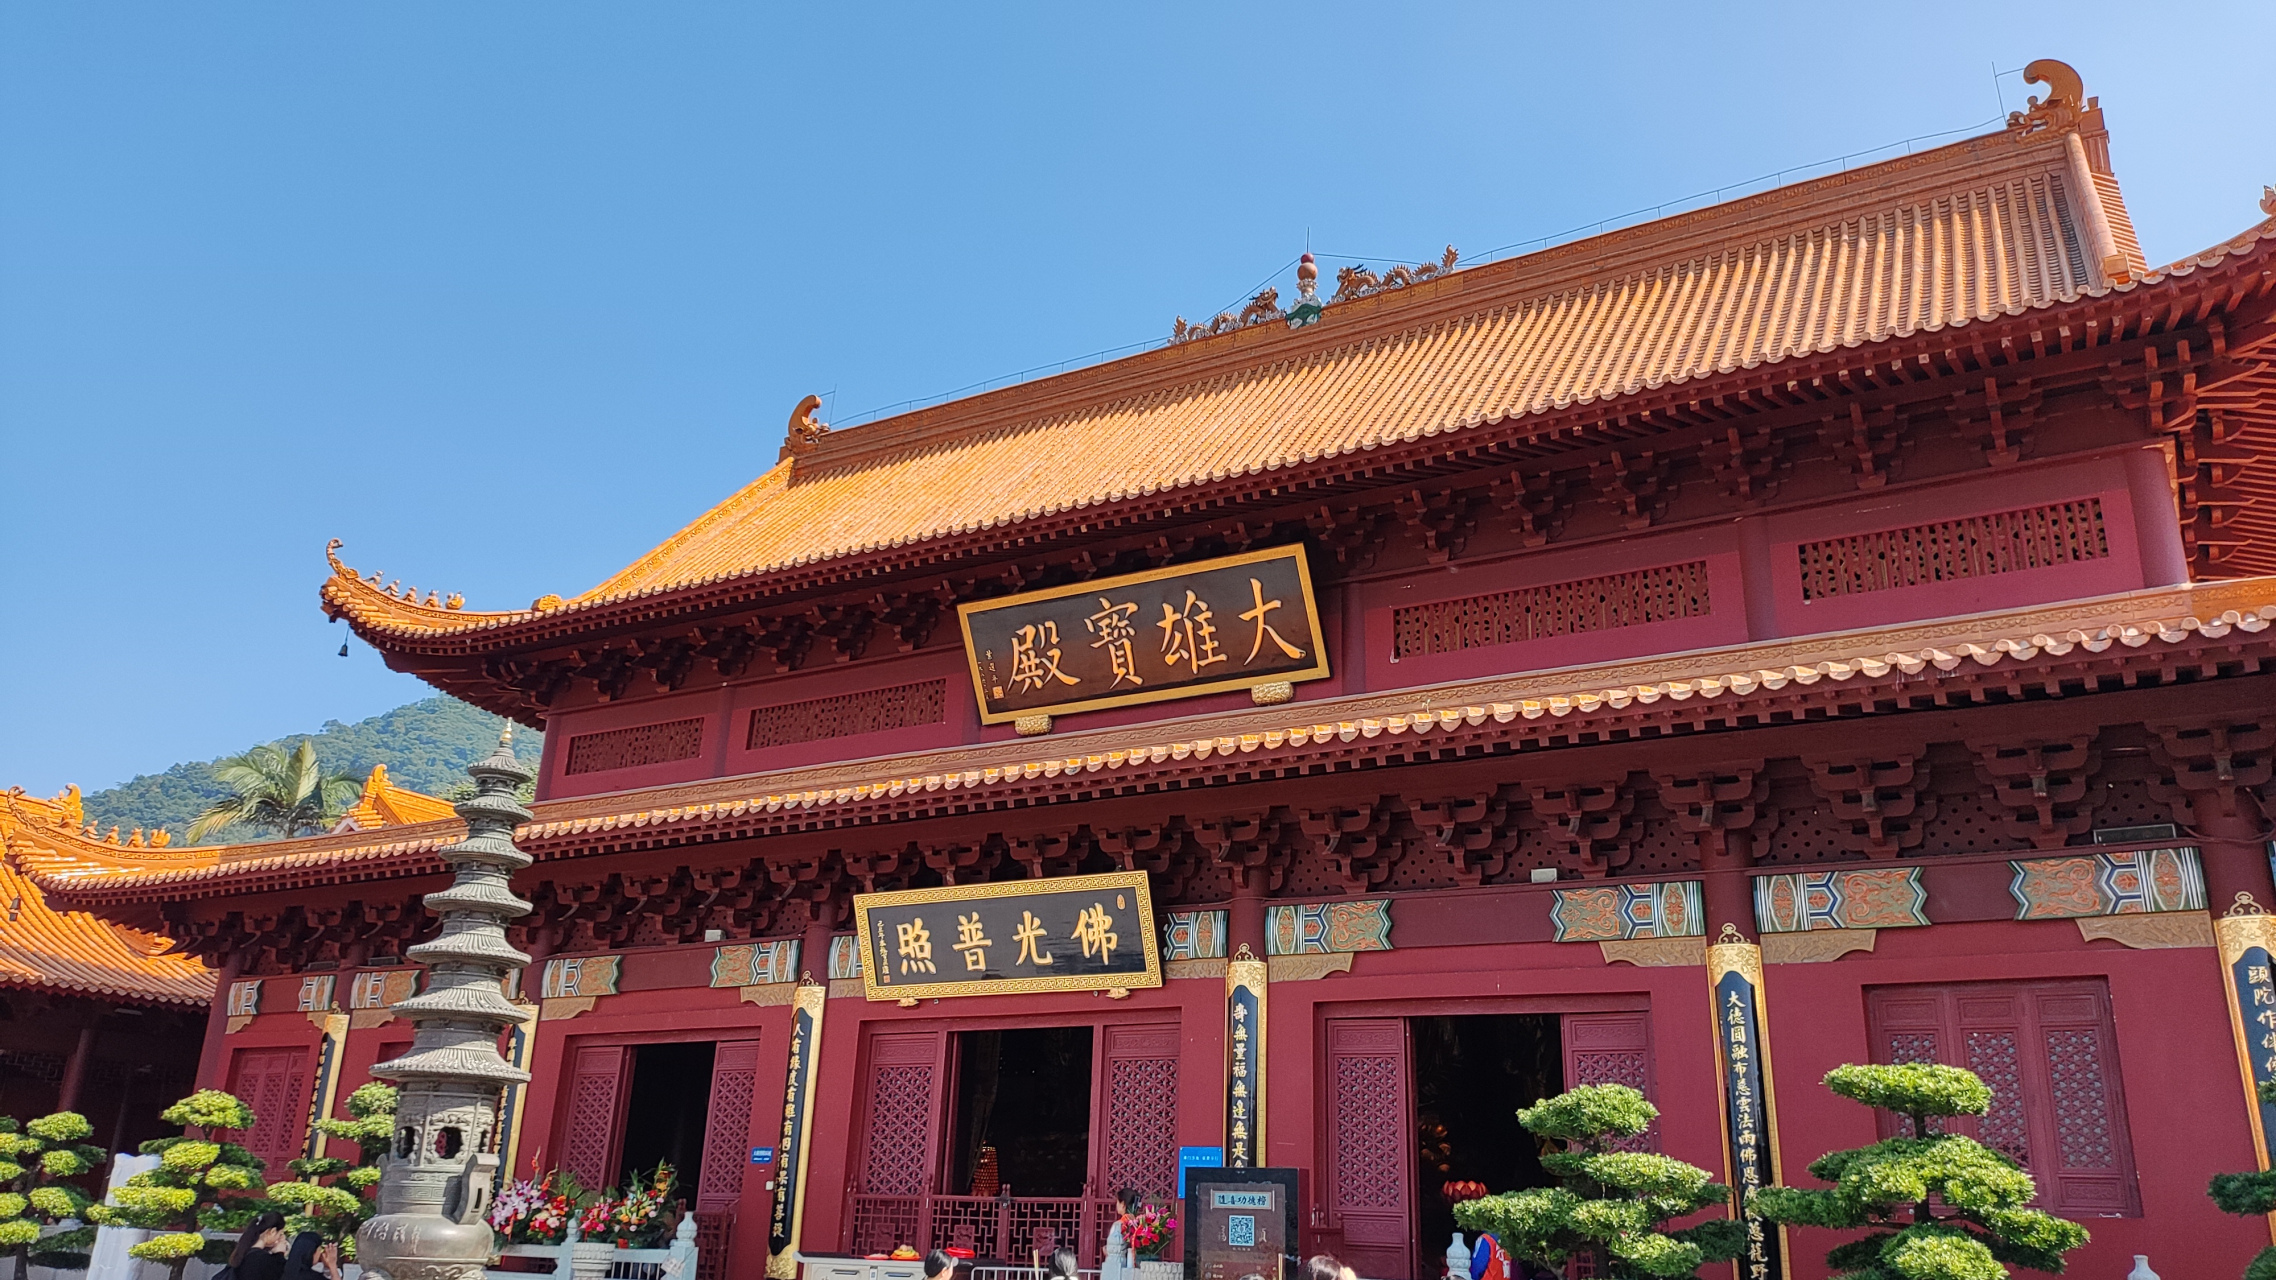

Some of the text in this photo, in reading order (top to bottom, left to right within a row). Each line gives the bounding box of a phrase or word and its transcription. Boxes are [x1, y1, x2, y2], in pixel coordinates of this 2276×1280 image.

[1007, 577, 1307, 695] 大雄寶殿
[896, 902, 1119, 976] 佛光普照
